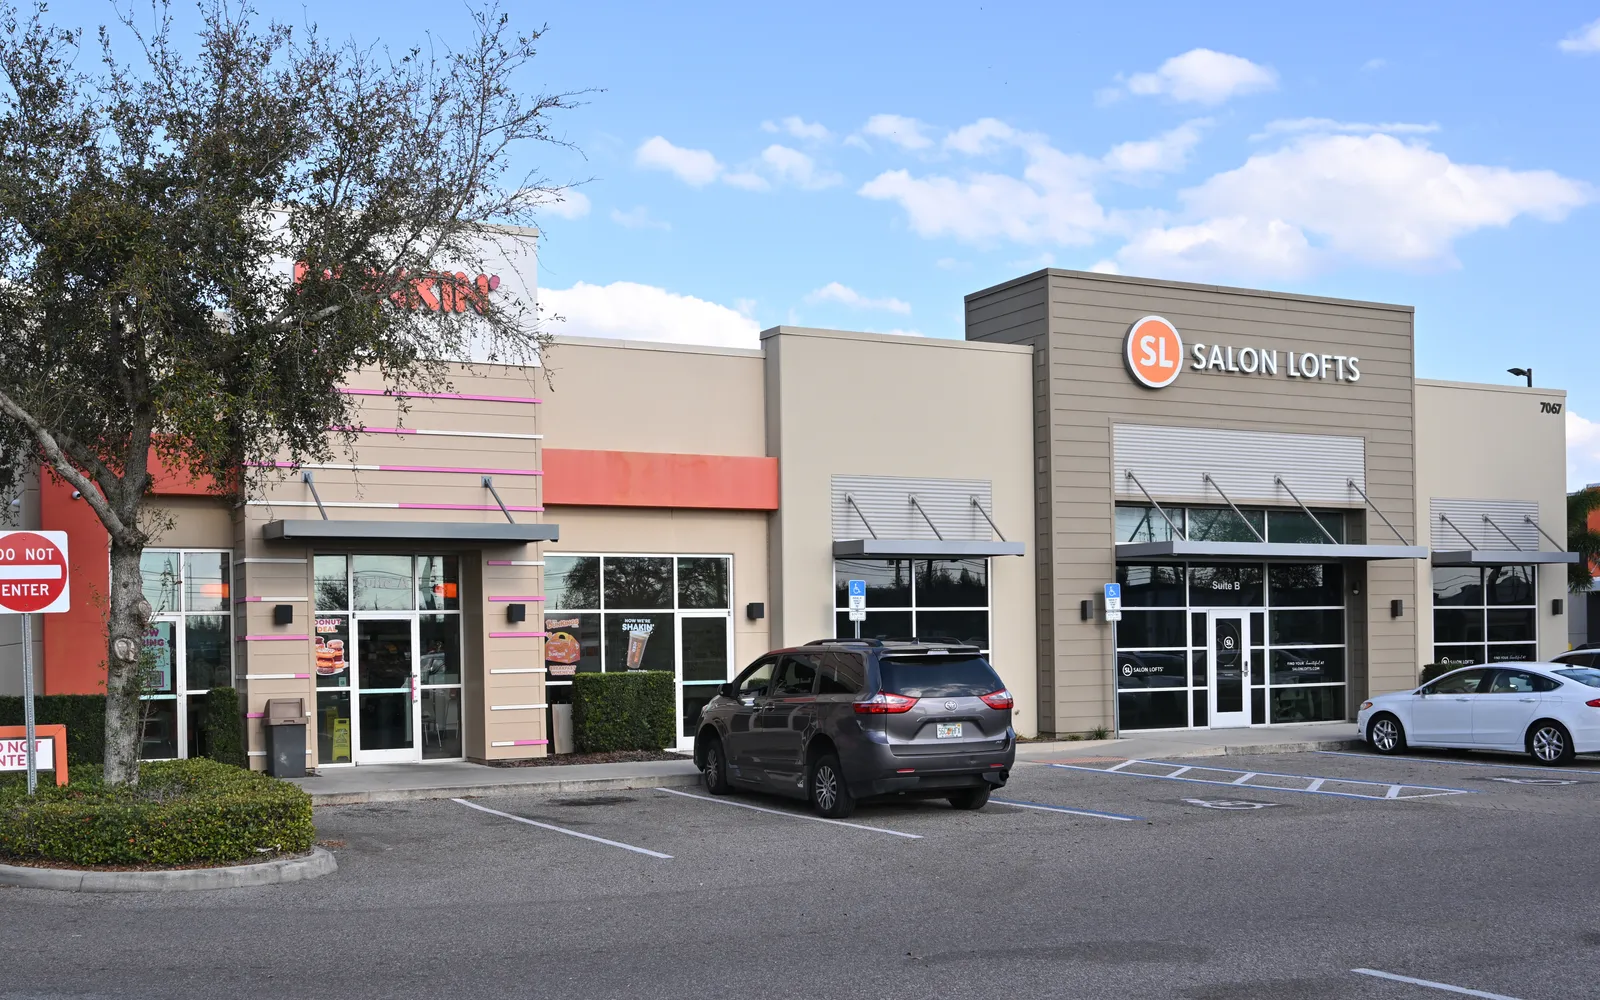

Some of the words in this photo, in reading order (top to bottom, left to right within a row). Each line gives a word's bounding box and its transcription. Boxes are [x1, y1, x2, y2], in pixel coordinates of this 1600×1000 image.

[1140, 335, 1173, 368] SL
[1191, 343, 1277, 375] SALON
[1288, 351, 1361, 382] LOFTS
[1540, 401, 1562, 414] 7067
[25, 548, 54, 561] NOT
[2, 583, 49, 597] ENTER
[1212, 580, 1232, 590] Suite
[1234, 581, 1240, 591] B
[142, 628, 160, 637] OW
[622, 623, 655, 631] SHAKIN'
[0, 754, 27, 767] NTE
